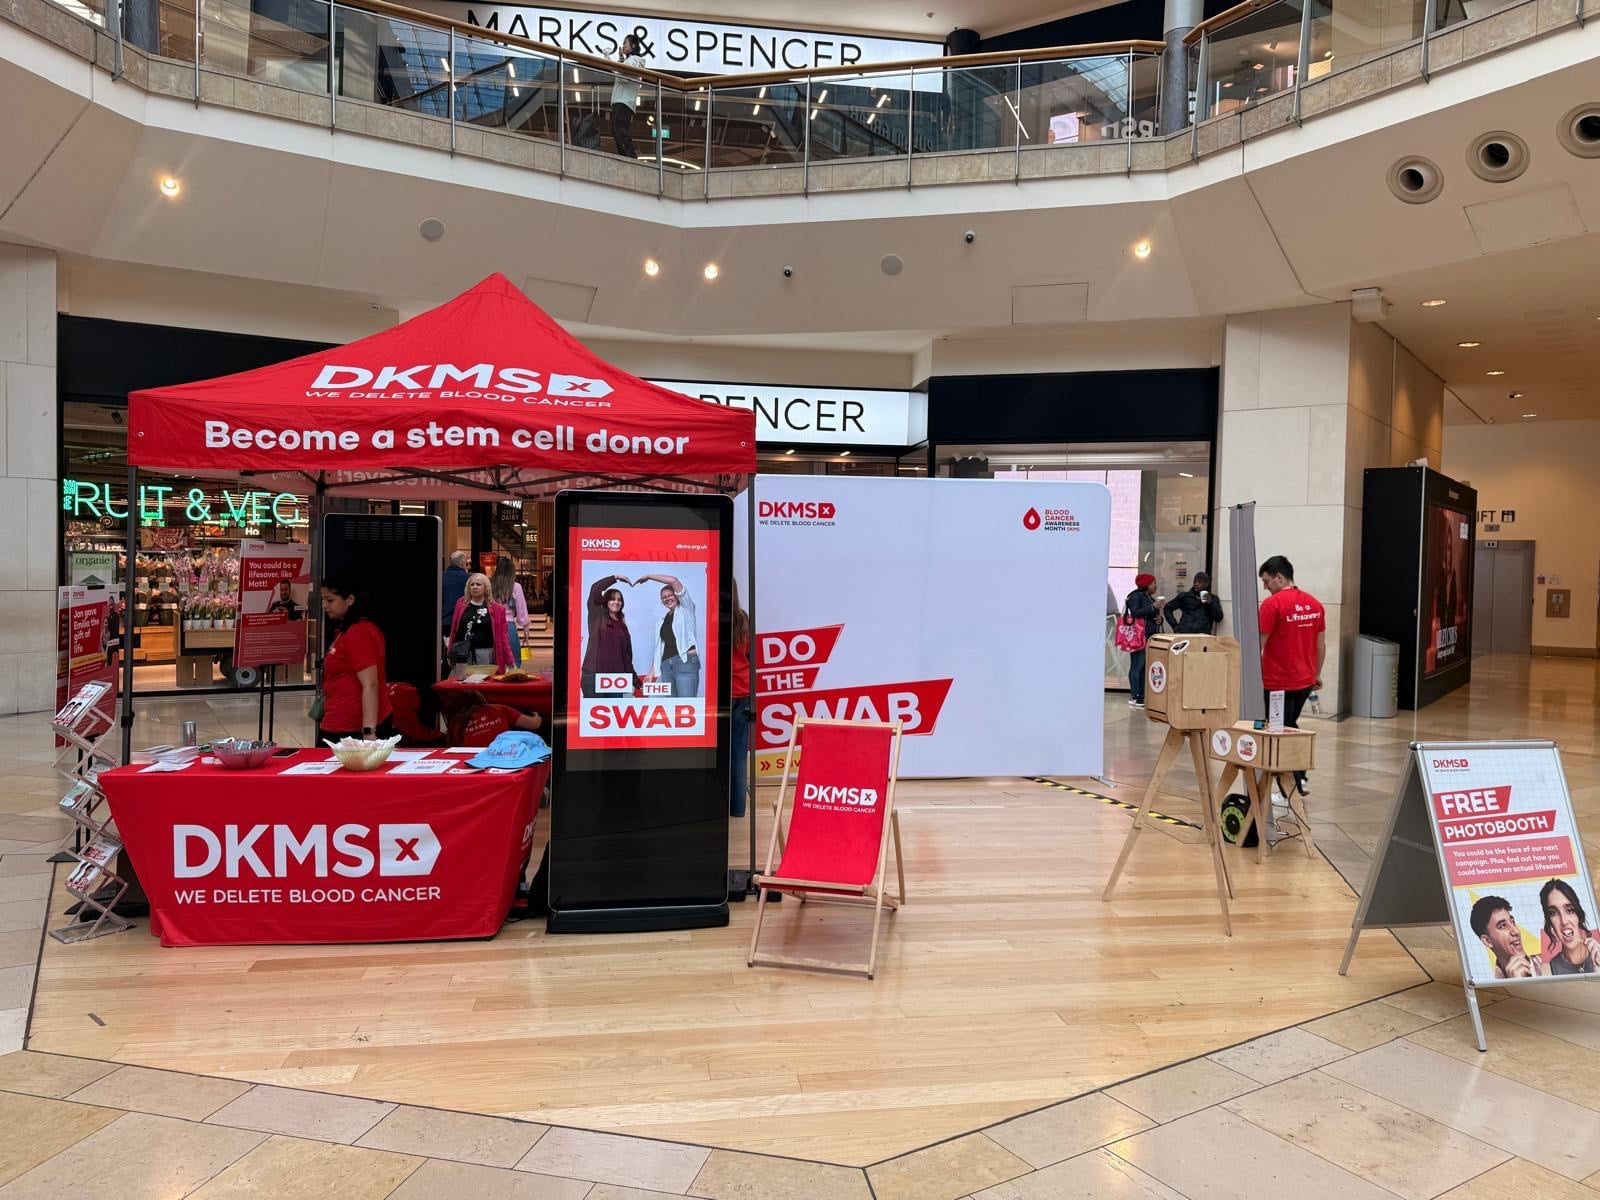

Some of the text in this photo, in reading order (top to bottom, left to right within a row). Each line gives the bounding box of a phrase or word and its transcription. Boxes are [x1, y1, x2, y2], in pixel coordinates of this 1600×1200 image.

[467, 10, 863, 68] MARKS & SPENCER
[311, 364, 542, 392] DKMS
[440, 391, 516, 402] BLOOD
[523, 397, 612, 408] CANCER
[699, 394, 865, 432] NCER
[205, 420, 690, 455] Become a stem cell donor
[75, 482, 172, 518] RUIT
[186, 488, 212, 521] &
[223, 490, 299, 524] VEG
[759, 502, 817, 518] DKMS
[1476, 511, 1496, 522] IFT
[582, 539, 611, 548] DKMS
[76, 556, 109, 566] organic
[74, 608, 97, 618] Jan gave
[74, 630, 91, 643] gift of
[74, 644, 83, 654] life
[762, 634, 816, 665] DO
[600, 677, 628, 689] DO
[645, 684, 668, 693] THE
[762, 672, 804, 692] THE
[589, 705, 696, 729] SWAB
[760, 691, 922, 744] SWAB
[1433, 760, 1460, 768] DKMS
[804, 784, 860, 804] DKMS
[1440, 790, 1500, 816] FREE
[1444, 816, 1548, 840] PHOTOBOOTH
[173, 824, 375, 878] DKMS
[1466, 848, 1484, 856] could
[1456, 859, 1489, 868] campaign.
[1458, 868, 1476, 876] could
[1476, 867, 1502, 875] become
[1513, 864, 1534, 872] actual
[174, 886, 441, 904] WE DELETE BLOOD CANCER
